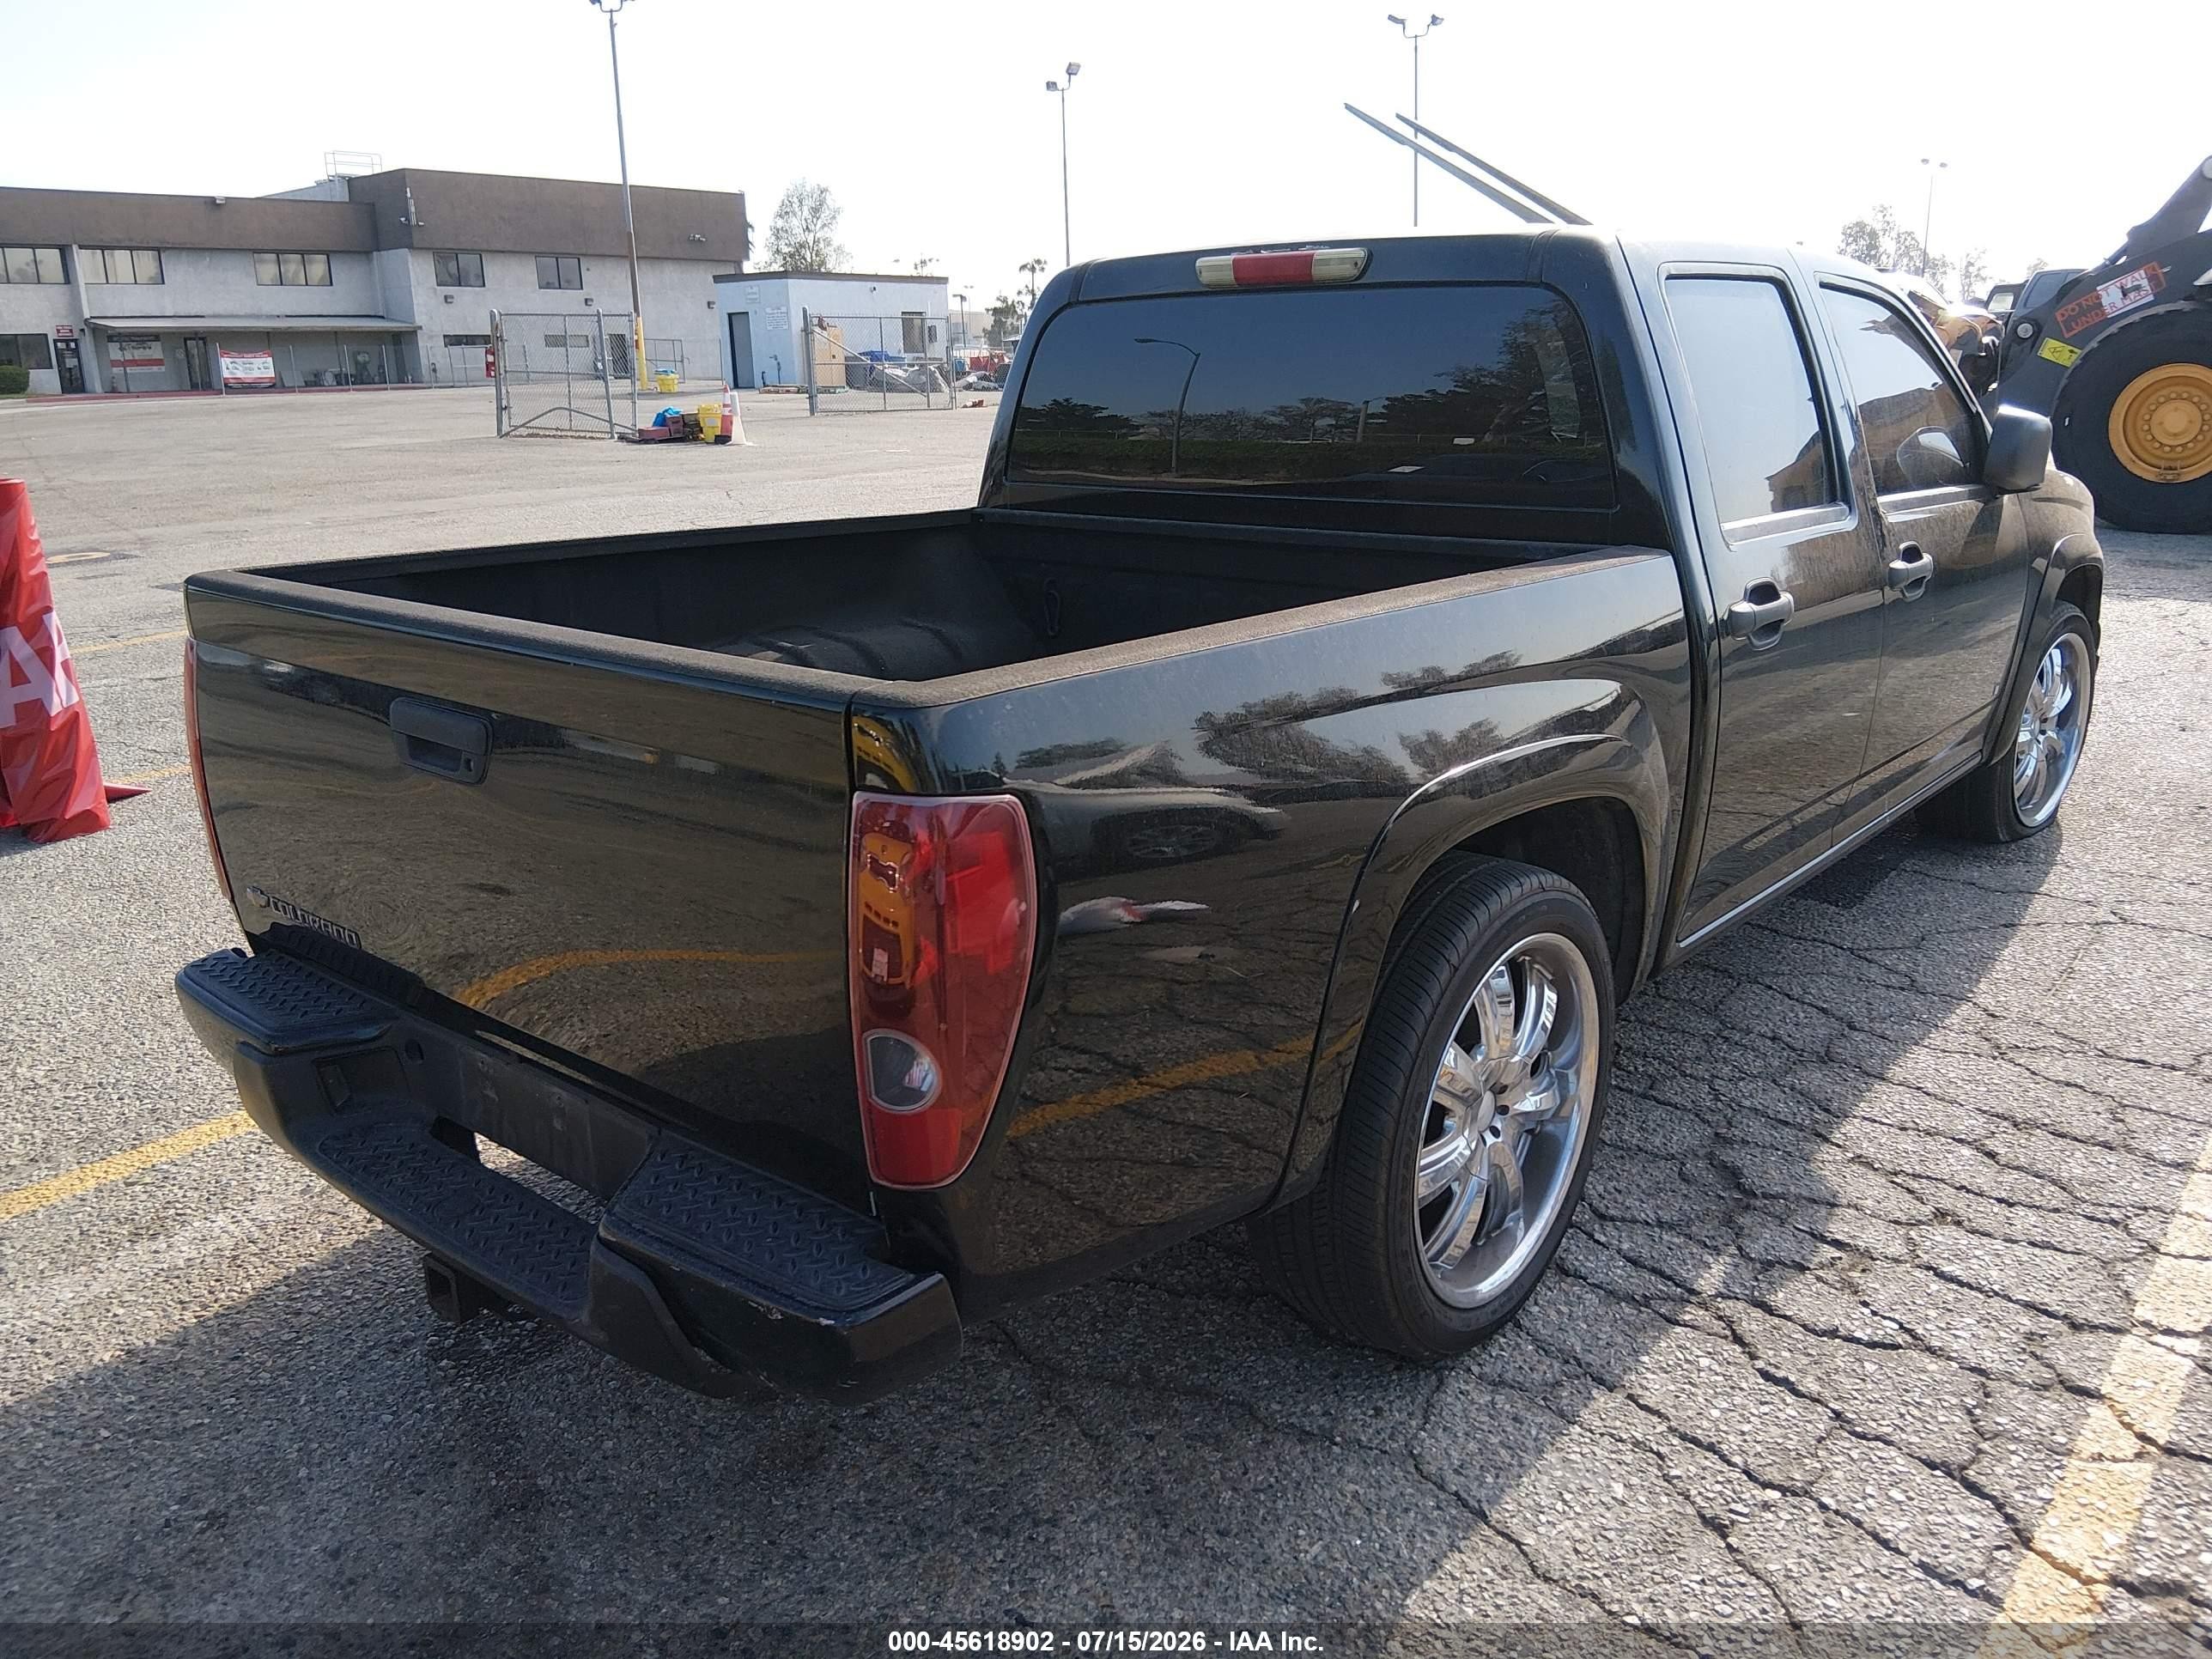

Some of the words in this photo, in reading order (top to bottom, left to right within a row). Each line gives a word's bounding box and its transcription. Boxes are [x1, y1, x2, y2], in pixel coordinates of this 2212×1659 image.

[2057, 304, 2079, 321] DO
[2081, 288, 2112, 308] NOT
[2115, 265, 2160, 289] WALK
[2071, 301, 2118, 329] UNDER
[2120, 281, 2159, 307] MAST
[270, 896, 358, 947] COLORADO
